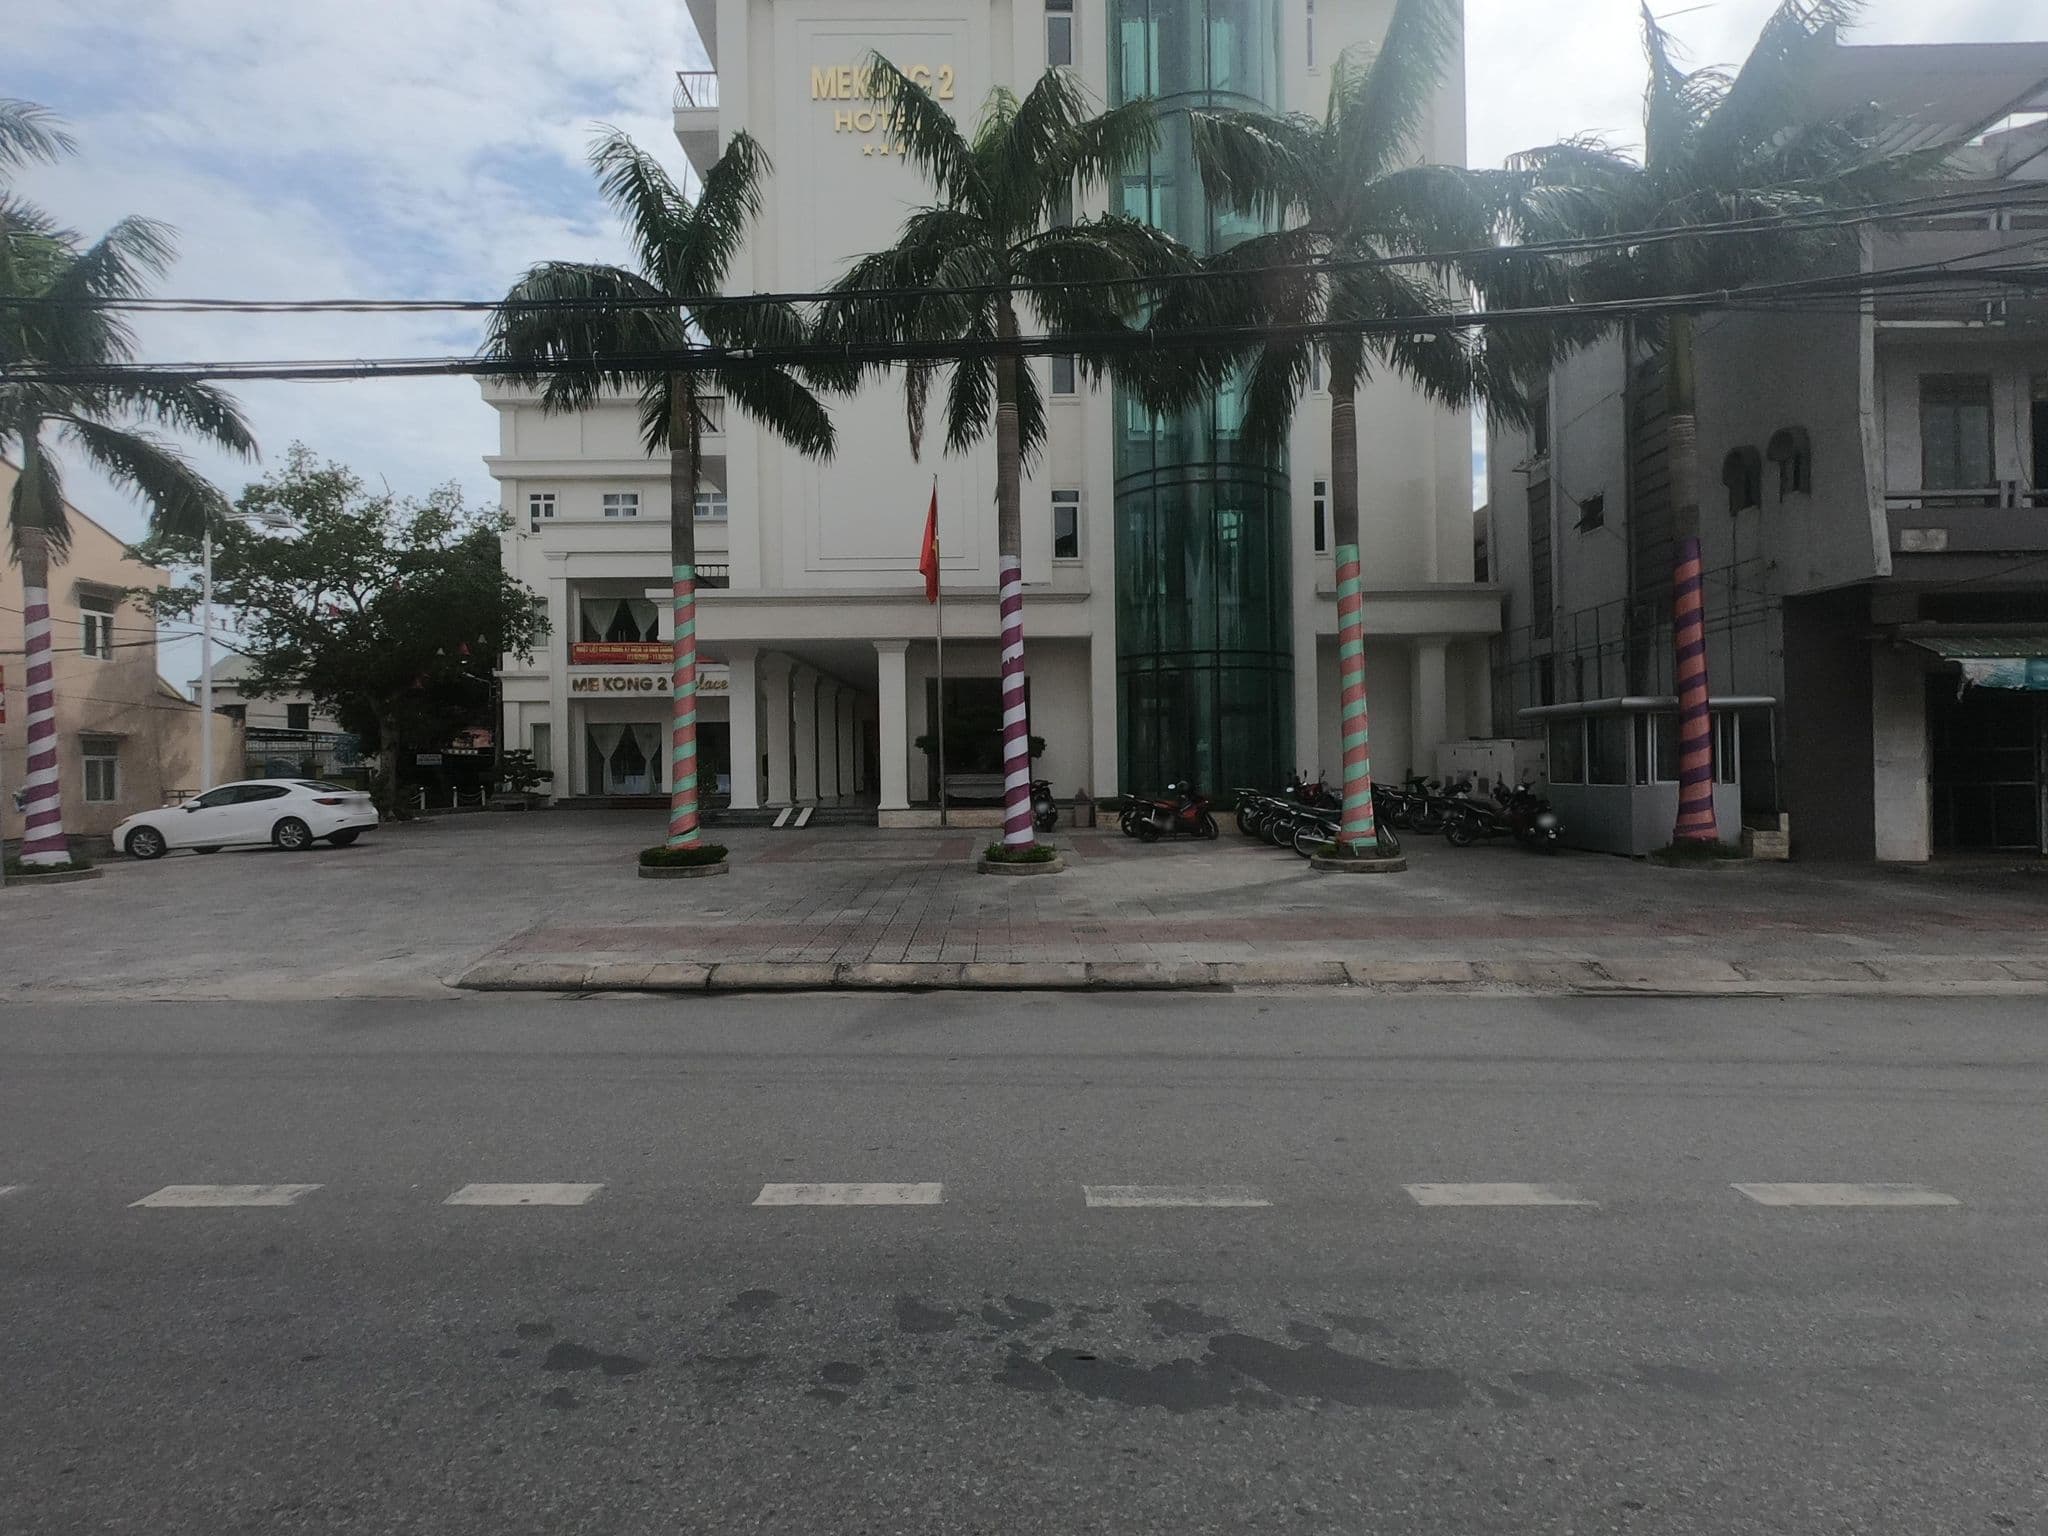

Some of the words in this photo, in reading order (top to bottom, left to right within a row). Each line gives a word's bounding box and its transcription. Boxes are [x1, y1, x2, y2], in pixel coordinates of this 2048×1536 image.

[811, 64, 931, 100] MEKOG
[938, 63, 955, 100] 2
[834, 109, 923, 133] HOTE
[657, 676, 668, 690] 2
